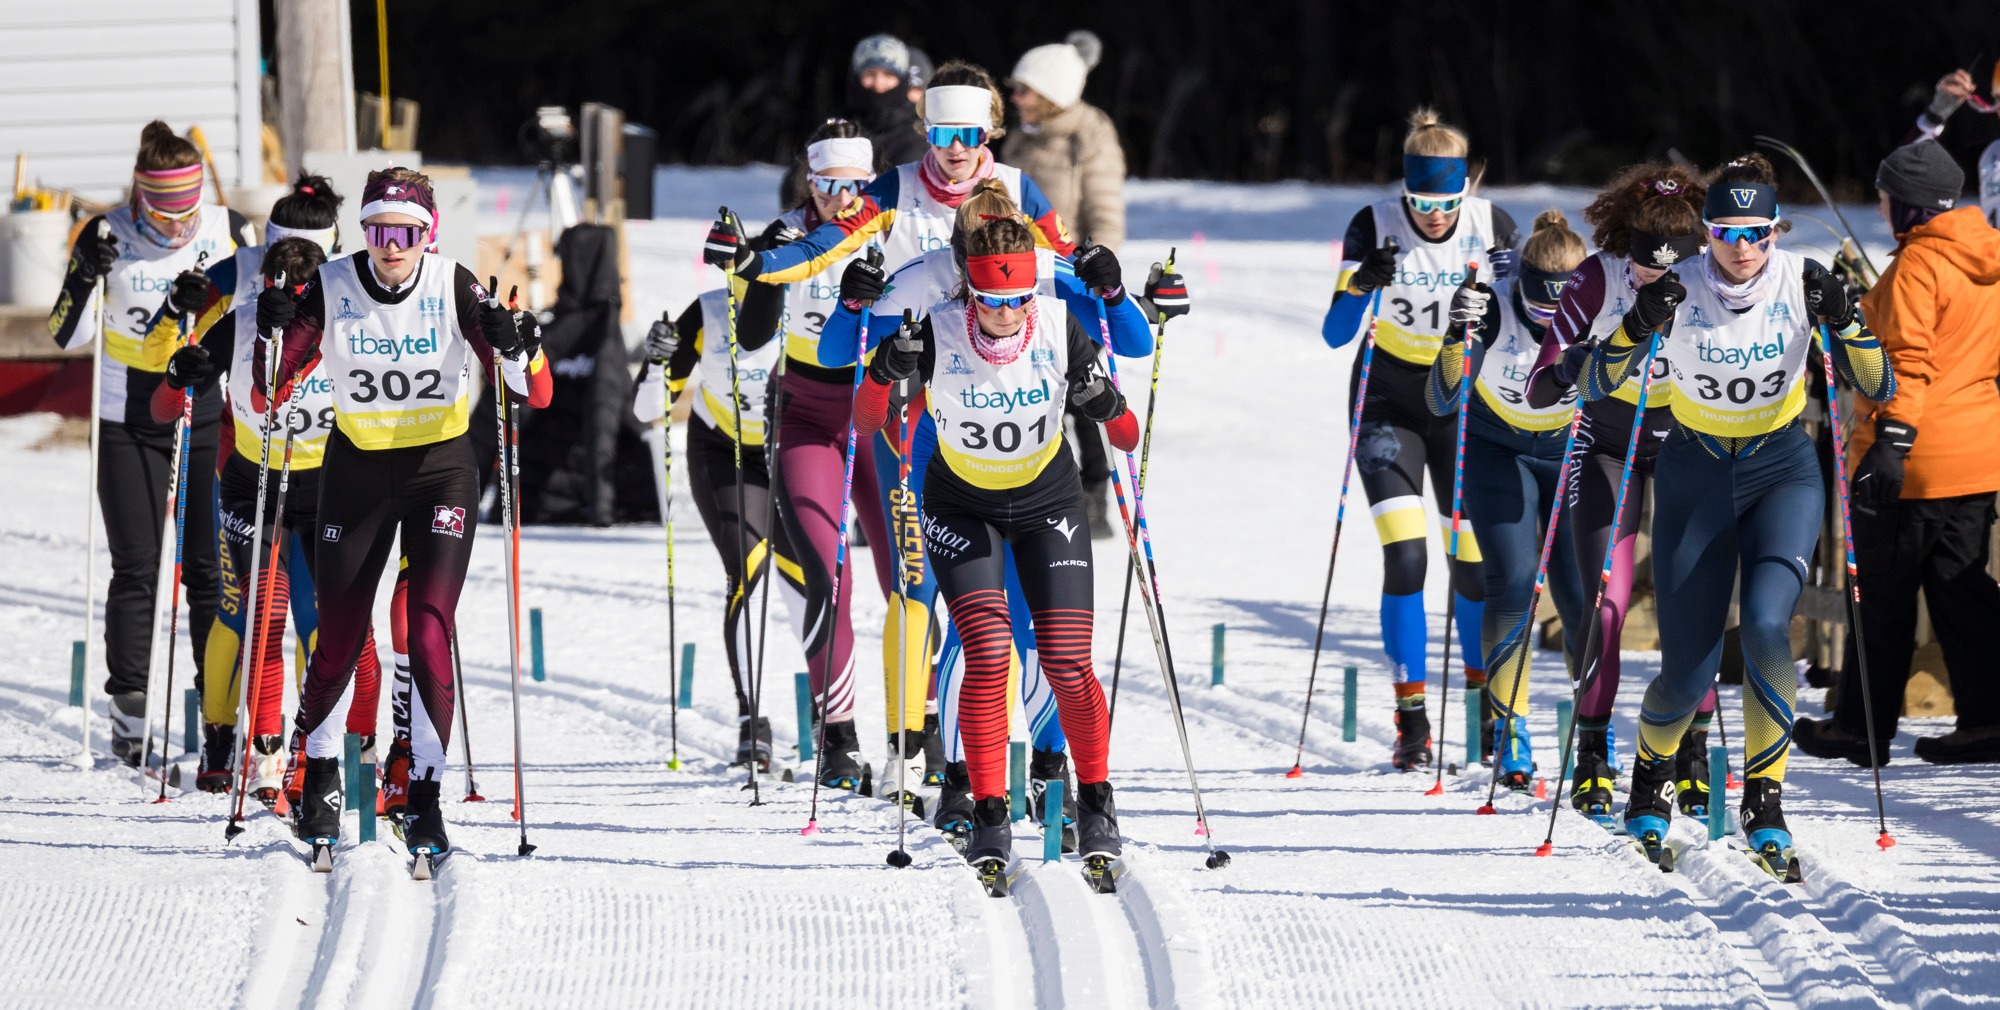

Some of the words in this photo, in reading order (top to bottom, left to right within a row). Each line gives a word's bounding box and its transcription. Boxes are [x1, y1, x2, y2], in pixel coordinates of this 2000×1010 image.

[1730, 188, 1757, 209] V
[1391, 297, 1440, 330] 31
[349, 328, 438, 362] tbaytel
[1697, 332, 1785, 370] tbaytel
[348, 368, 445, 403] 302
[960, 379, 1050, 414] tbaytel
[1694, 370, 1786, 405] 303
[355, 415, 416, 429] THUNDER
[419, 411, 445, 422] BAY
[1698, 408, 1757, 424] THUNDER
[960, 415, 1047, 453] 301
[965, 459, 1024, 473] THUNDER
[431, 528, 463, 539] McMASTER
[921, 494, 970, 552] arleton
